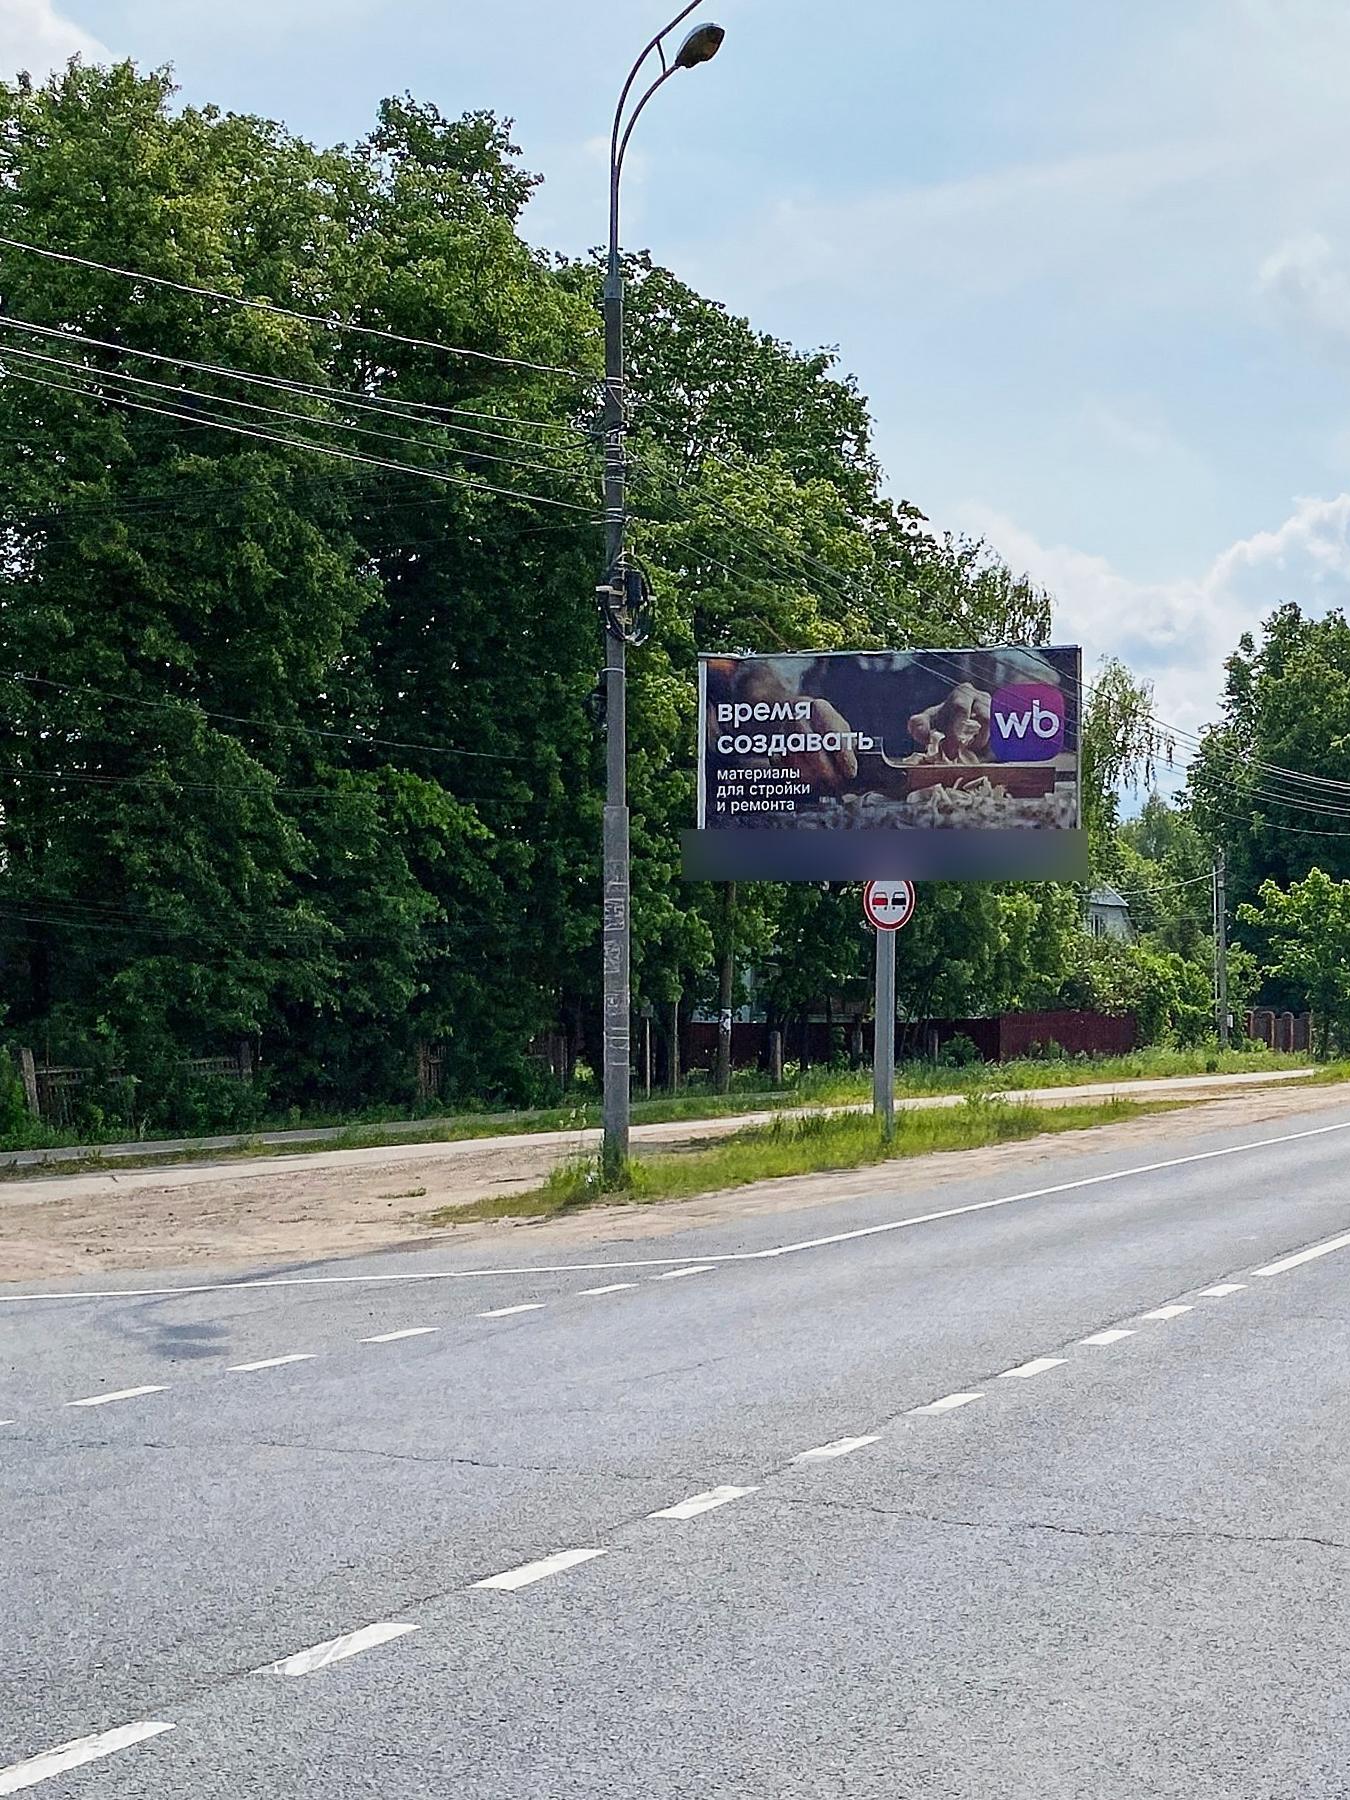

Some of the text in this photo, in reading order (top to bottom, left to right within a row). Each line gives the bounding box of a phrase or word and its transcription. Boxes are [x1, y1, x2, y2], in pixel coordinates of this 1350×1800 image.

[717, 701, 812, 729] время
[994, 700, 1060, 739] wb
[717, 731, 874, 757] создавать
[717, 767, 800, 783] материалы
[716, 782, 811, 798] для стройки
[716, 799, 795, 815] и ремонта
